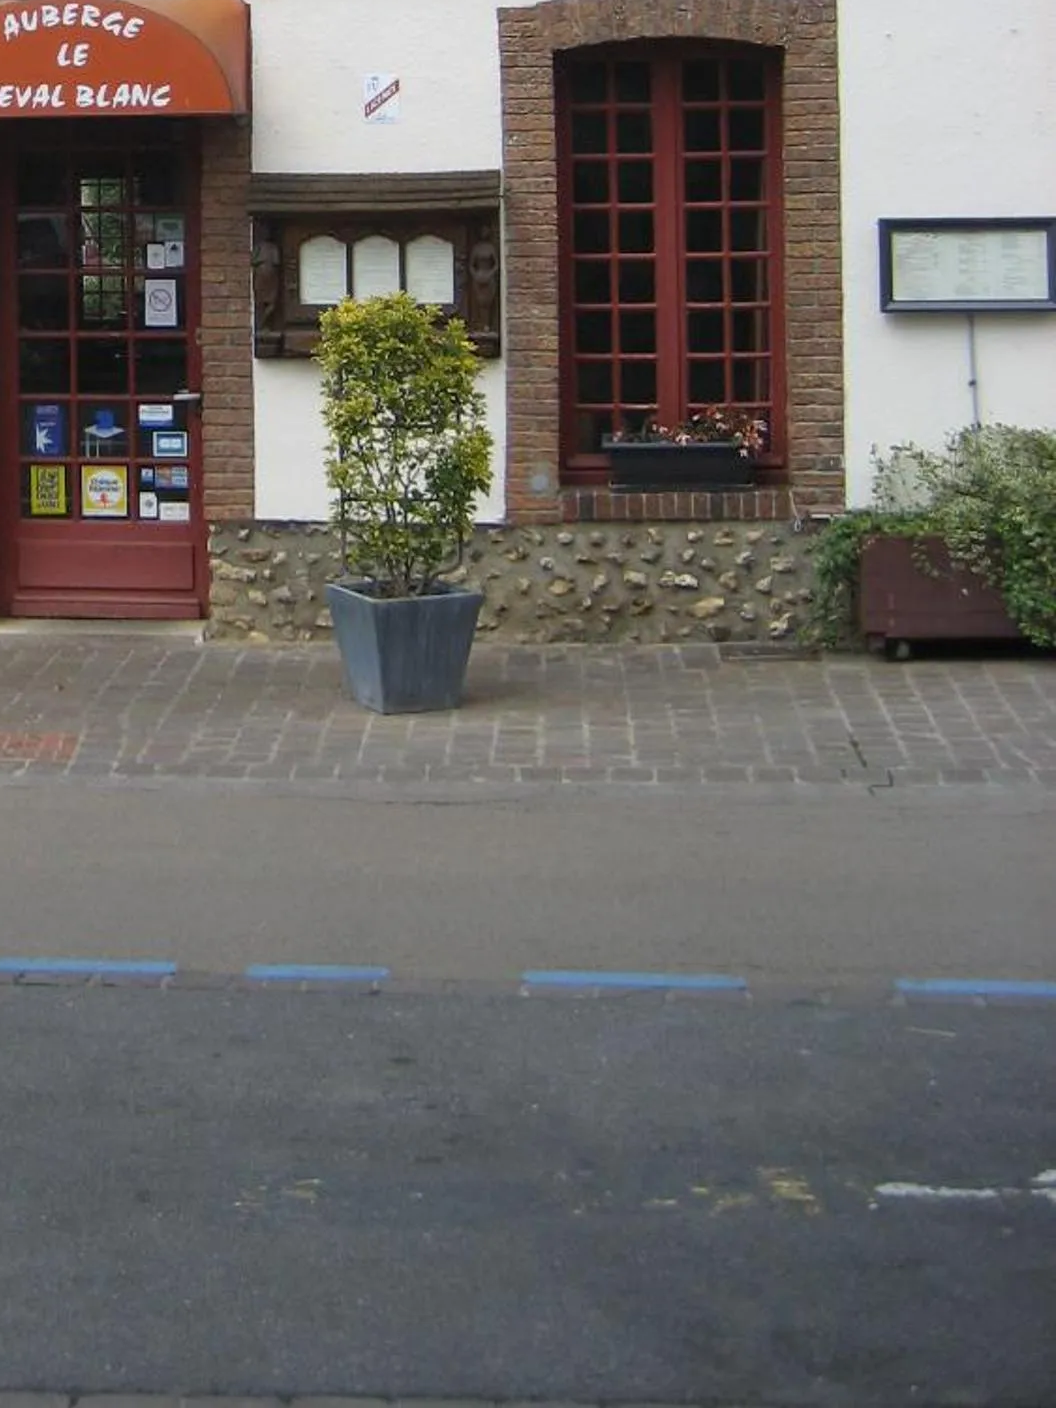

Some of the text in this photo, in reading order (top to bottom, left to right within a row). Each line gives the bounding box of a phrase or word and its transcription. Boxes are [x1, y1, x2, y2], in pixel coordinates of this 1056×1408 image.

[3, 3, 145, 41] AUBERGE
[56, 42, 90, 67] LE
[75, 83, 172, 108] BLANC
